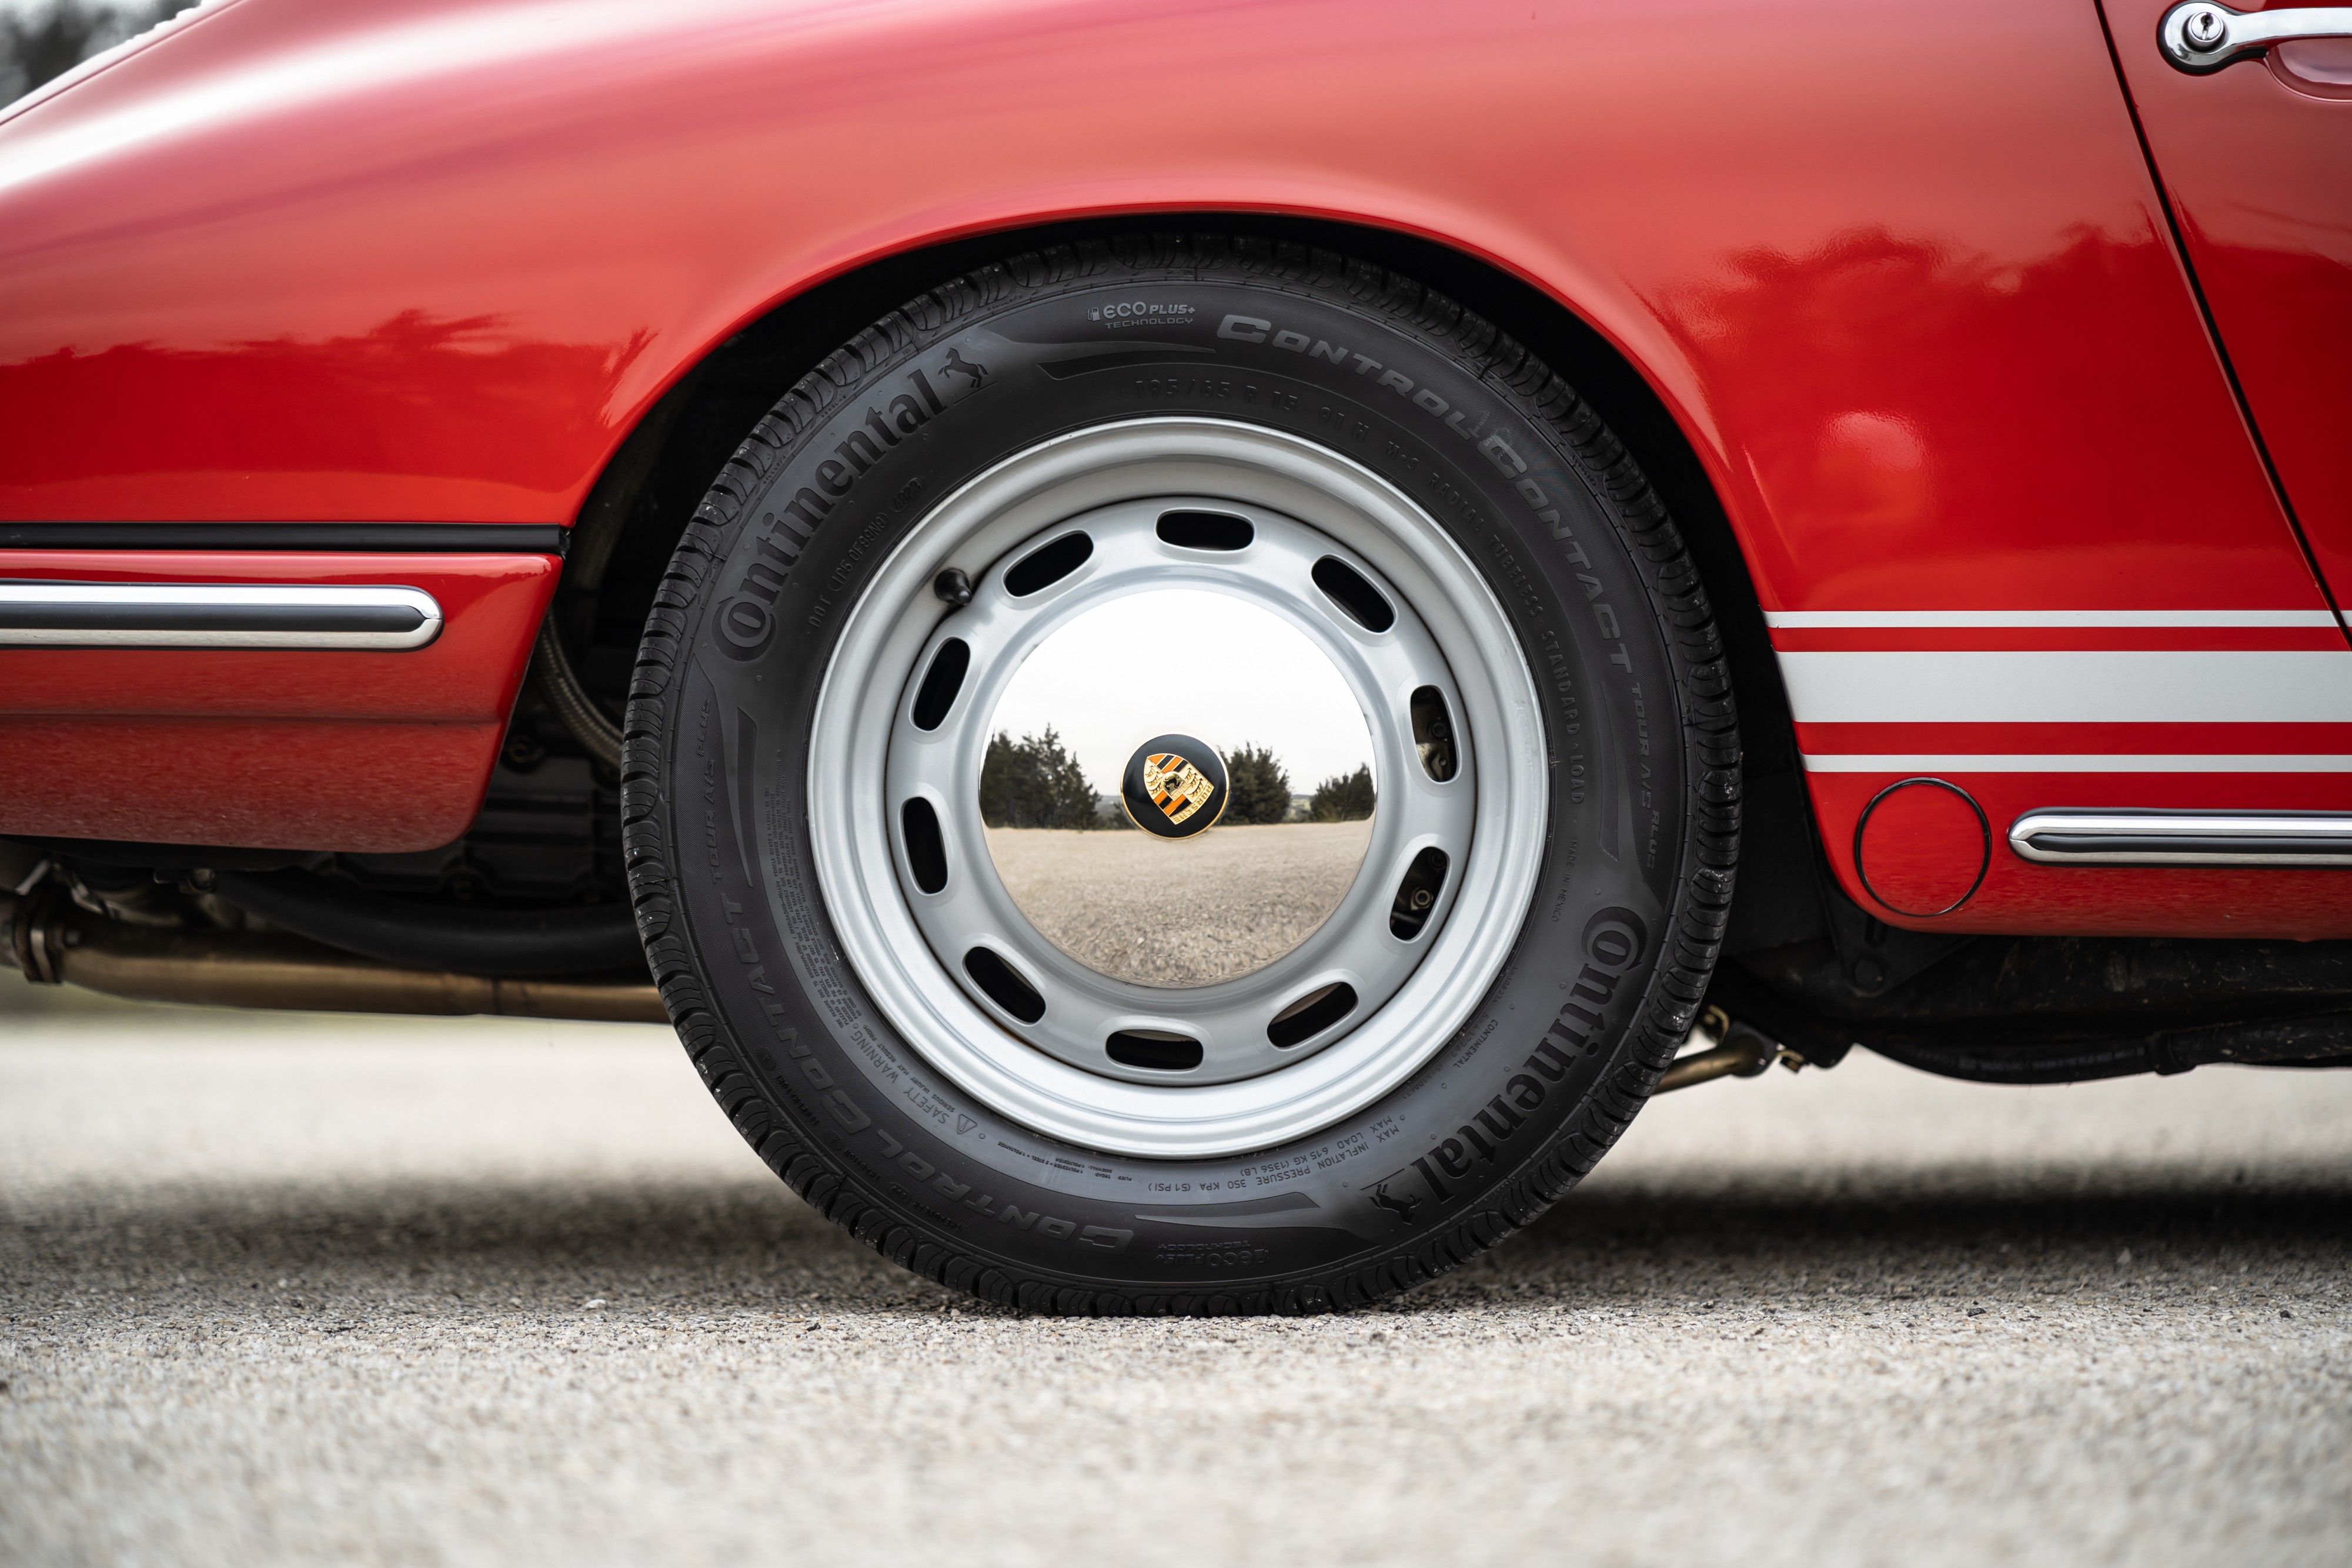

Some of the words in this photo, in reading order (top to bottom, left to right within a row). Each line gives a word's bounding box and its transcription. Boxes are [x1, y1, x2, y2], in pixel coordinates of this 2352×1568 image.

[1102, 301, 1147, 320] ECO
[1104, 317, 1193, 329] TECHNOLOGY
[711, 367, 950, 662] Continental
[1135, 379, 1231, 401] 195/65
[1242, 385, 1259, 405] R
[1269, 390, 1299, 415] 15
[1315, 405, 1346, 432] 91
[1349, 420, 1371, 443] H
[1424, 470, 1488, 533] RADIAL
[1483, 533, 1545, 618] TUBELESS
[1538, 628, 1581, 735] STANDARD
[1568, 754, 1585, 805] LOAD
[807, 594, 833, 628] DOT
[1630, 682, 1649, 757] TOUR
[1645, 810, 1660, 870] PLUS
[1172, 784, 1212, 823] PORSCHE
[1565, 840, 1578, 867] MADE
[1562, 872, 1572, 884] IN
[1550, 888, 1568, 923] MEXICO
[876, 1041, 897, 1064] RESULT
[1452, 1018, 1499, 1071] CONTINENTAL
[850, 1028, 901, 1084] WARNING
[1410, 906, 1647, 1206] Continental
[896, 1062, 910, 1076] MAY
[909, 1074, 931, 1094] INJURY
[901, 1084, 950, 1126] SAFETY
[930, 1092, 956, 1114] SERIOUS
[1368, 1114, 1392, 1134] MAX
[1375, 1124, 1400, 1144] MAX
[1335, 1131, 1364, 1151] LOAD
[1030, 1154, 1045, 1164] STEEL
[1292, 1154, 1307, 1166] KG
[1309, 1145, 1329, 1160] 615
[1316, 1139, 1369, 1171] INFLATION
[1240, 1166, 1257, 1178] LB)
[1255, 1163, 1311, 1187] PRESSURE
[1260, 1159, 1289, 1175] (1356
[1174, 1182, 1190, 1192] (51
[1199, 1181, 1219, 1191] KPA
[1227, 1178, 1246, 1189] 350
